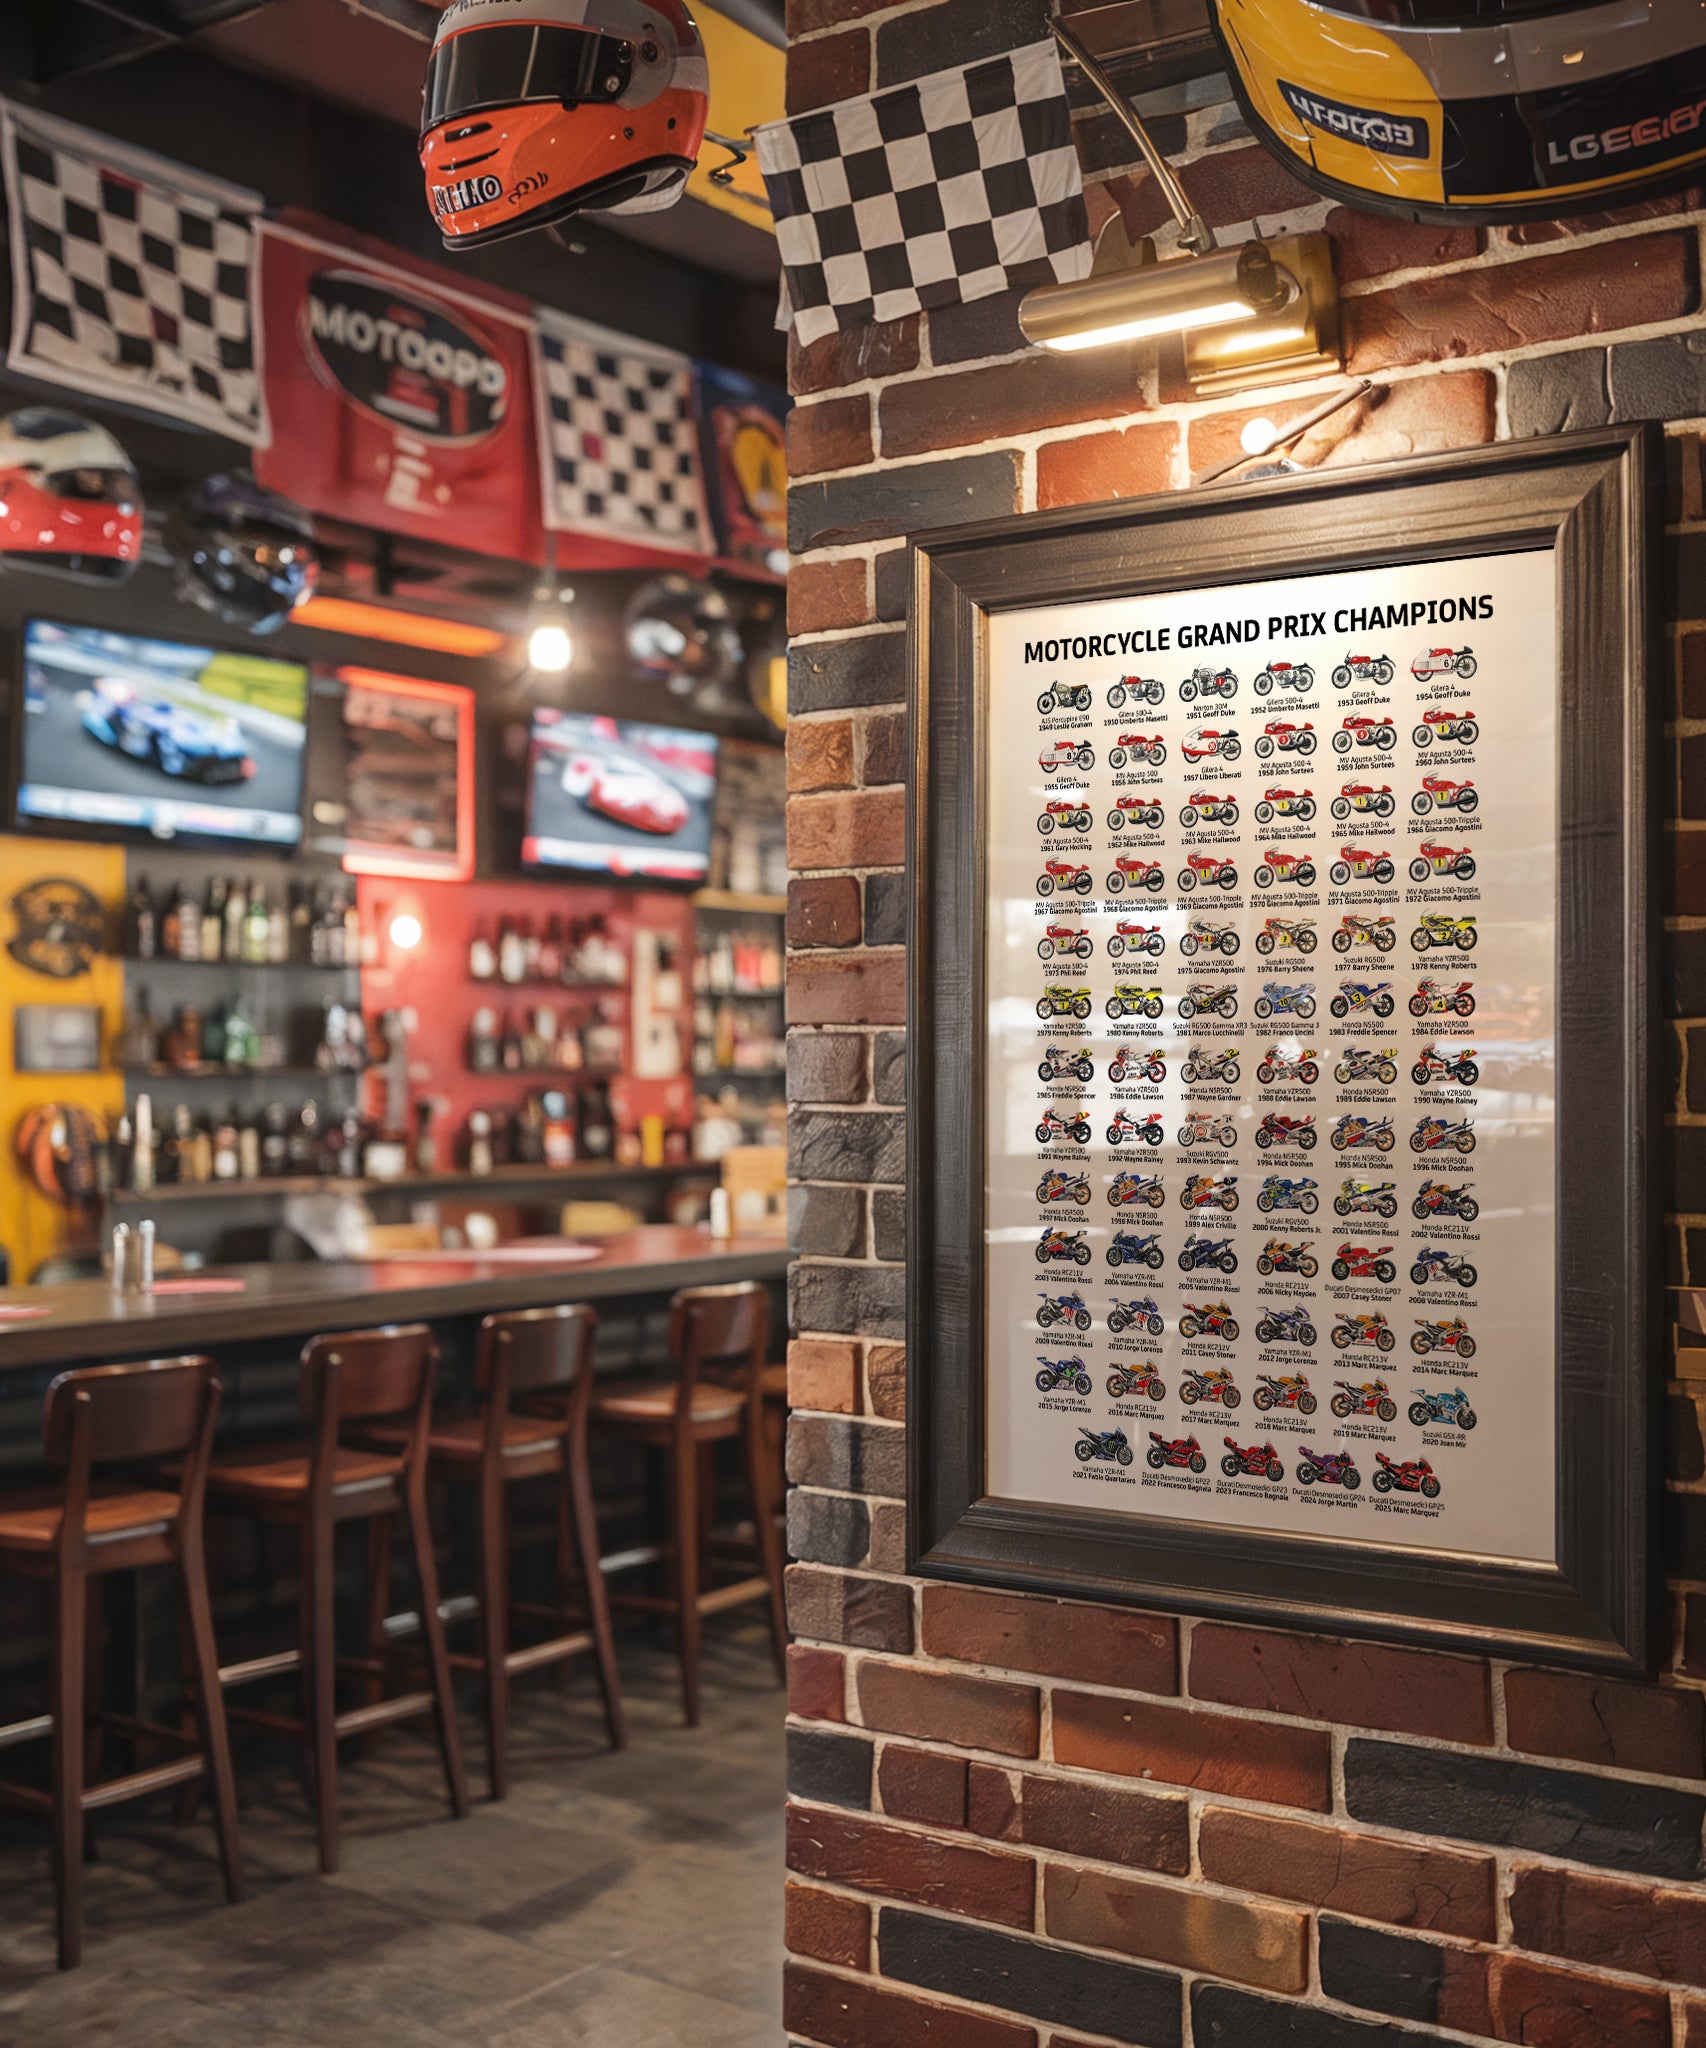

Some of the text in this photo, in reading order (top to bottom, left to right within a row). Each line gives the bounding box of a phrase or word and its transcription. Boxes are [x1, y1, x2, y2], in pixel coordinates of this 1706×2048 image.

[1024, 594, 1494, 664] MOTORCYCLE GRAND PRIX CHAMPIONS
[1415, 690, 1470, 701] 1954 Geoff Duke
[1337, 696, 1390, 707] 1953 Geoff Duke
[1250, 706, 1266, 714] 1952
[1295, 702, 1319, 711] Masetti
[1202, 710, 1218, 718] Geoff
[1449, 756, 1475, 764] Surtees
[1370, 761, 1395, 769] Surtees
[1219, 771, 1241, 779] Liberati
[1406, 824, 1482, 834] 1966 Giacomo Agostini
[1418, 887, 1440, 896] Agusta
[1344, 897, 1371, 905] Giacomo
[1373, 896, 1399, 905] Agostini
[1405, 894, 1480, 903] 1972 Giacomo Agostini
[1293, 899, 1320, 908] Agostini
[1220, 967, 1245, 975] Agostini
[1274, 966, 1289, 974] Barry
[1352, 964, 1369, 972] Barry
[1429, 963, 1449, 971] Kenny
[1371, 1029, 1397, 1037] Spencer
[1196, 1094, 1216, 1102] Wayne
[1432, 1097, 1453, 1105] Wayne
[1455, 1097, 1477, 1106] Rainey
[1352, 1161, 1367, 1169] Mick
[1412, 1163, 1429, 1171] 1996
[1269, 1225, 1288, 1233] Kenny
[1289, 1225, 1313, 1233] Roberts
[1350, 1228, 1380, 1236] Valentino
[1381, 1229, 1399, 1237] Rossi
[1429, 1231, 1460, 1240] Valentino
[1462, 1233, 1480, 1241] Rossi
[1257, 1287, 1273, 1295] 2006
[1274, 1288, 1291, 1297] Nicky
[1332, 1292, 1392, 1302] 2007 Casey Stoner
[1408, 1296, 1425, 1304] 2008
[1427, 1298, 1458, 1306] Valentino
[1258, 1354, 1317, 1365] 2012 Jorge Lorenzo
[1333, 1360, 1396, 1373] 2013 Marc Marquez
[1411, 1366, 1477, 1379] 2014 Marc Marquez
[1254, 1422, 1315, 1436] 2018 Marc Marquez
[1333, 1429, 1396, 1443] 2019 Marc Marquez
[1421, 1437, 1466, 1448] 2020 Joan Mir
